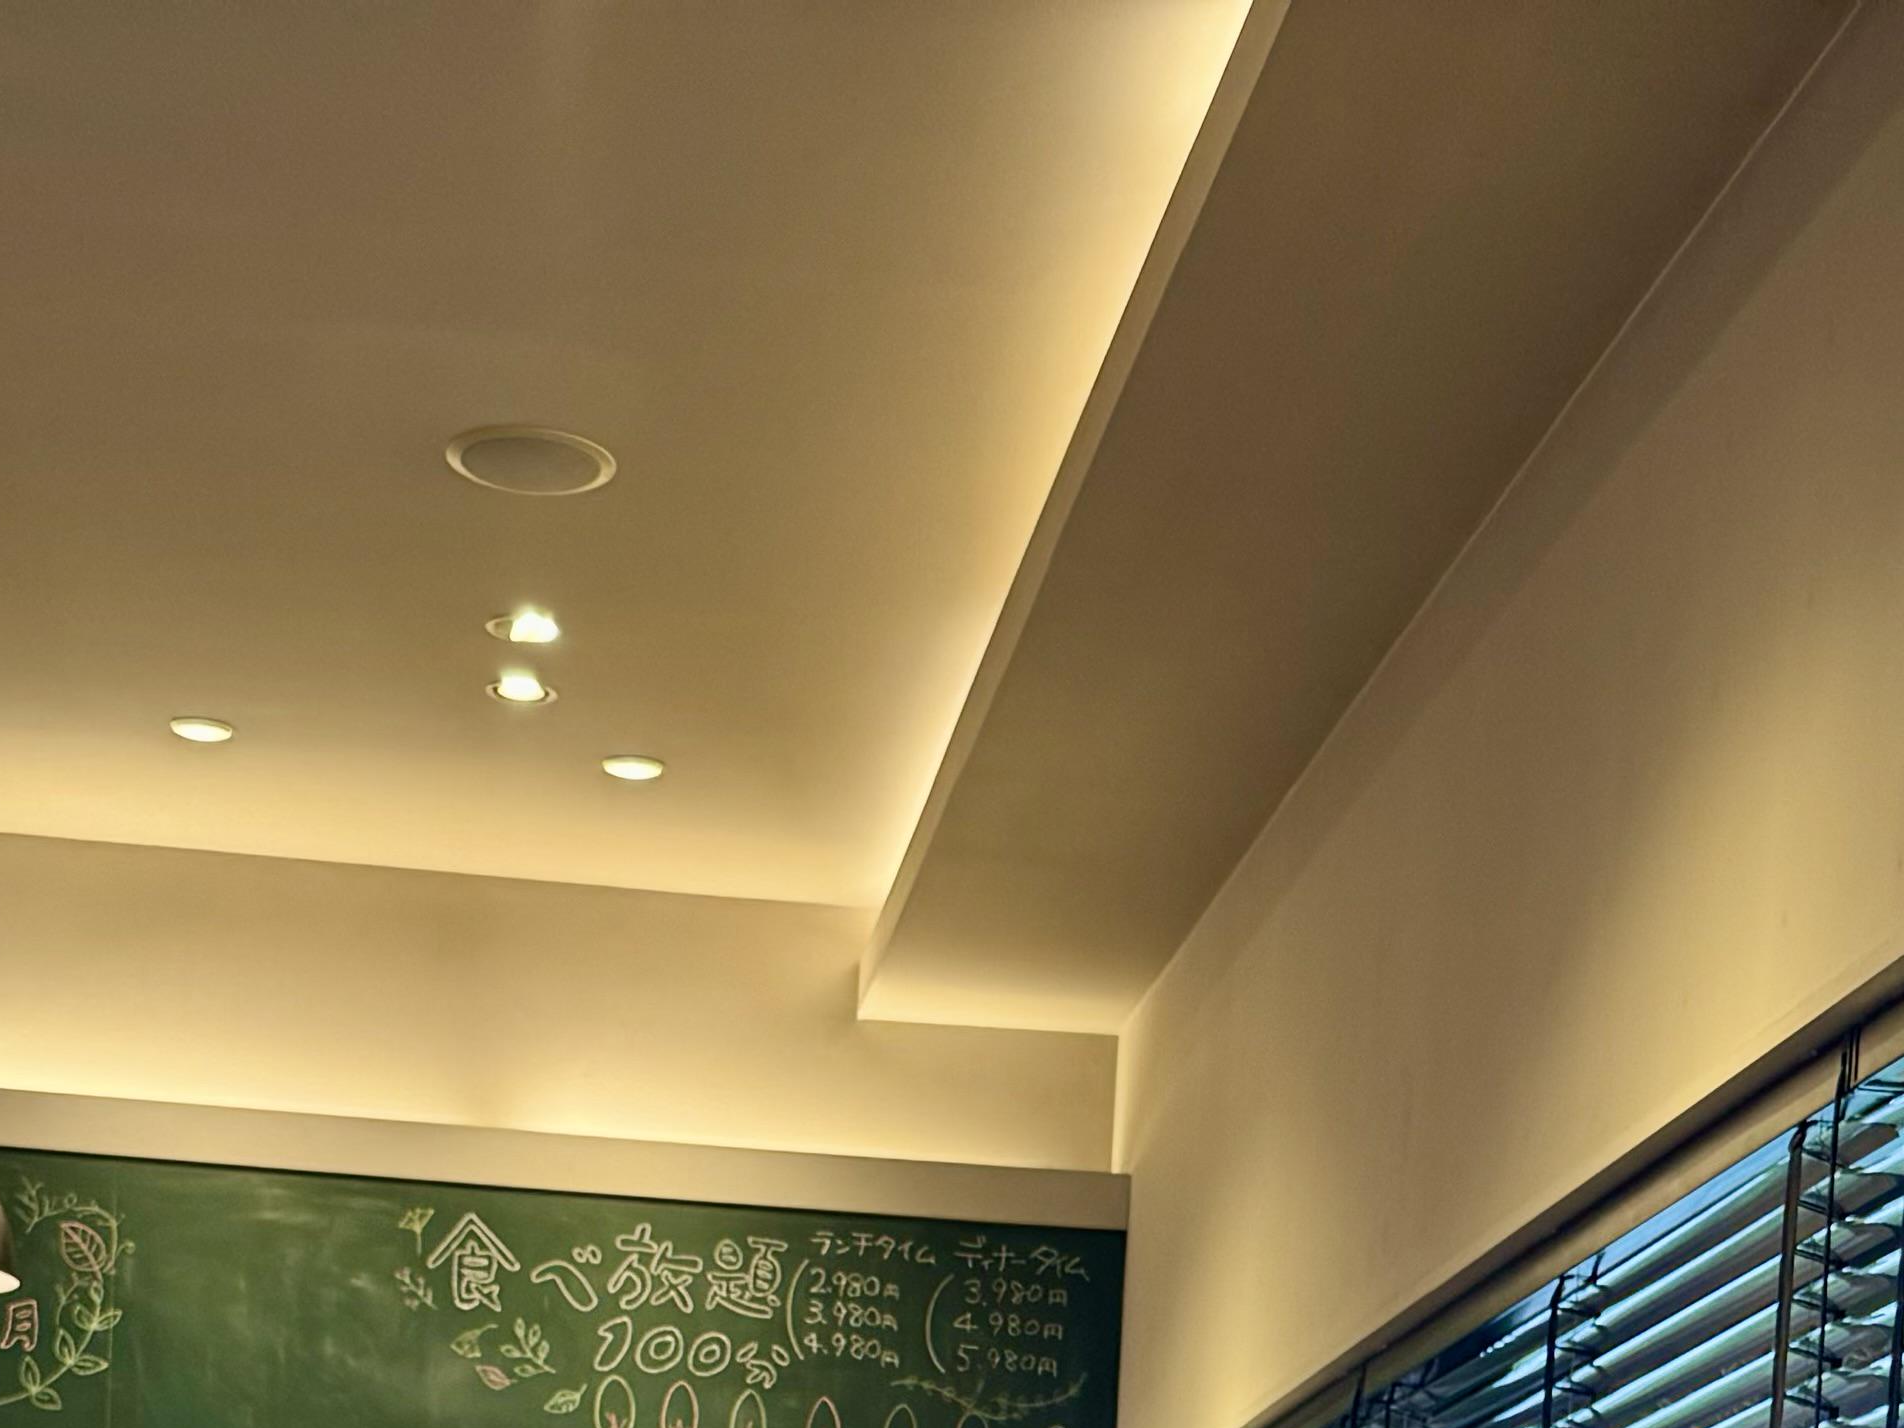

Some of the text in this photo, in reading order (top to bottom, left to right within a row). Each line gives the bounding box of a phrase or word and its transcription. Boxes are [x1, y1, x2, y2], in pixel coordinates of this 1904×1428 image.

[427, 1211, 788, 1319] 食べ放題
[811, 1231, 936, 1265] ランチタイム
[594, 1315, 790, 1389] 100分
